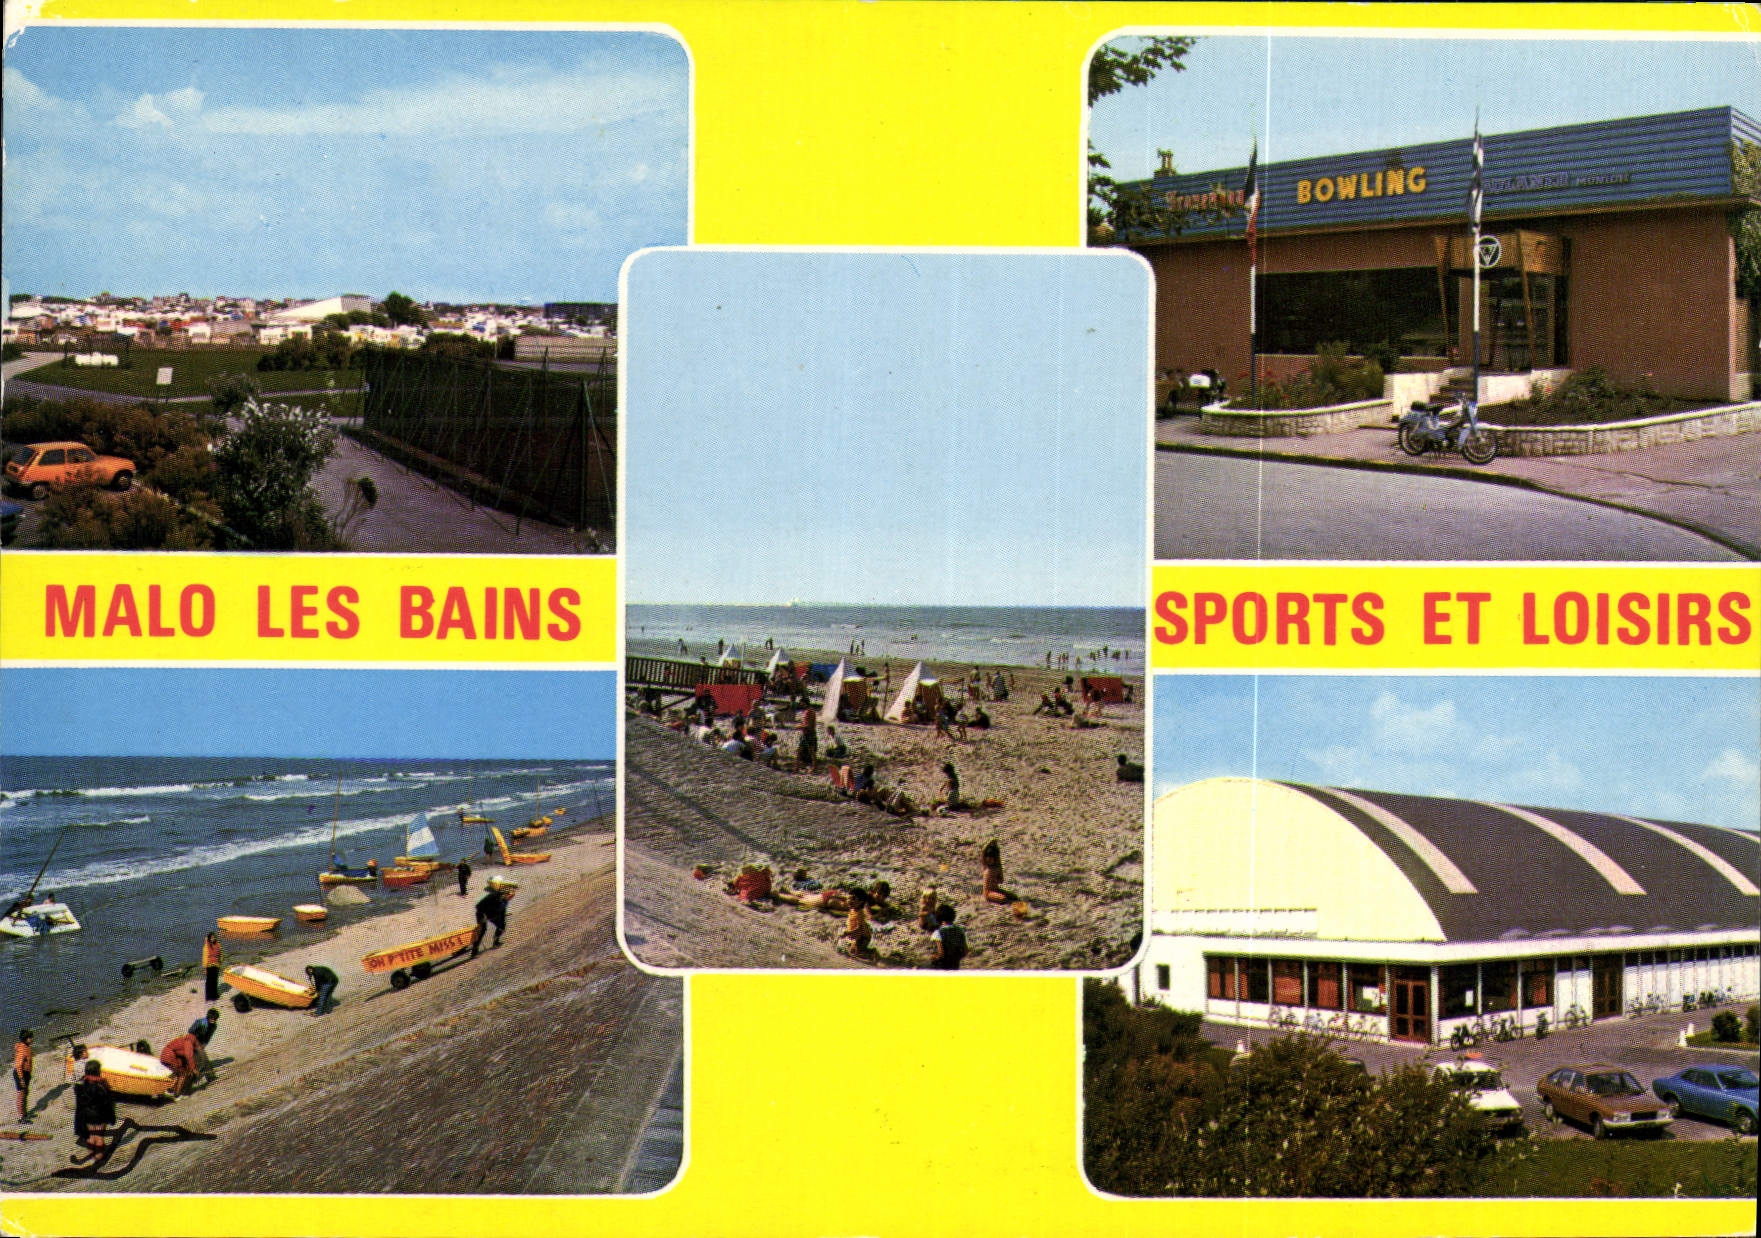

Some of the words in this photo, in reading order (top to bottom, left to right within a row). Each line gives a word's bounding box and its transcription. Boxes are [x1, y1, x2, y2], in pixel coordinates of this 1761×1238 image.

[1297, 167, 1426, 204] BOWLING
[368, 958, 386, 969] OH
[428, 938, 456, 955] MISS
